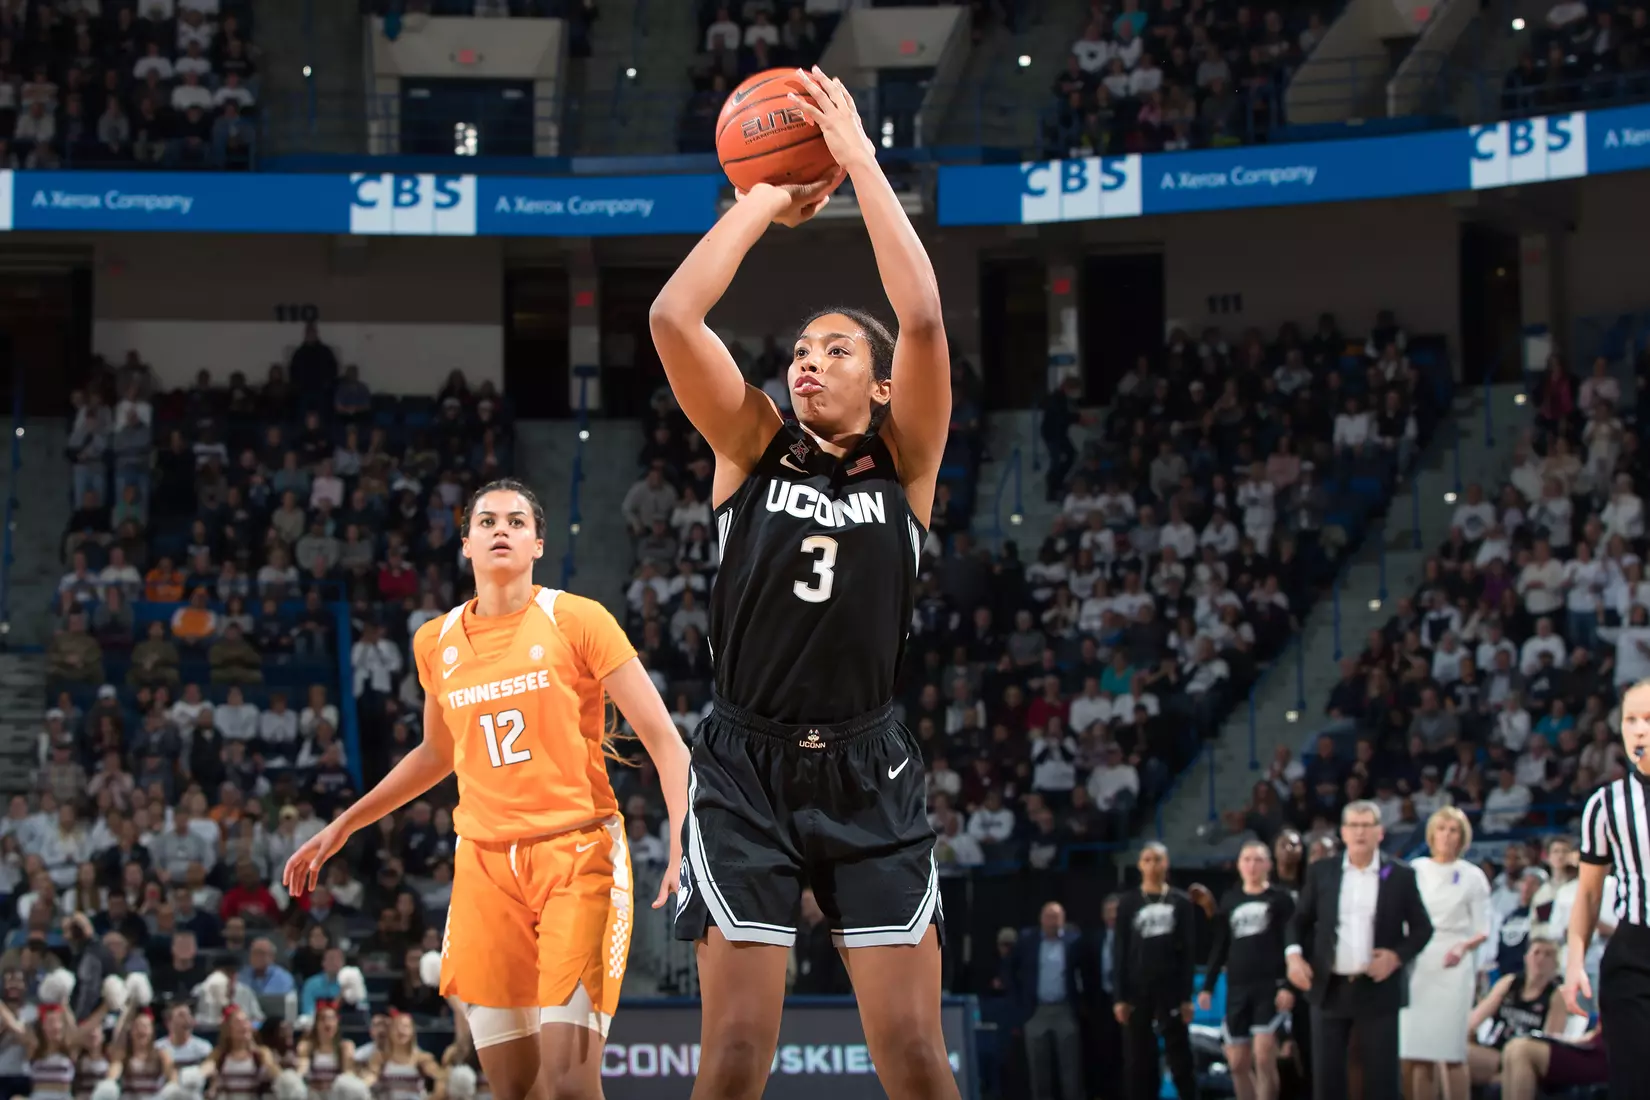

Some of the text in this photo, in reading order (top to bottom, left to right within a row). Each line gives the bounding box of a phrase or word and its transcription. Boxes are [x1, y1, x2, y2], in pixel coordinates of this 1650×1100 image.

[741, 106, 806, 138] ELITE
[1469, 112, 1572, 161] CBS
[1603, 129, 1619, 149] A
[350, 173, 461, 208] CBS
[1021, 156, 1127, 196] CBS
[1160, 165, 1317, 190] A Xerox Company
[32, 189, 193, 214] A Xerox Company
[495, 195, 654, 217] A Xerox Company
[765, 479, 886, 528] UCONN
[793, 535, 838, 603] 3
[448, 669, 550, 709] TENNESSEE
[479, 708, 532, 768] 12
[799, 740, 826, 749] UCONN
